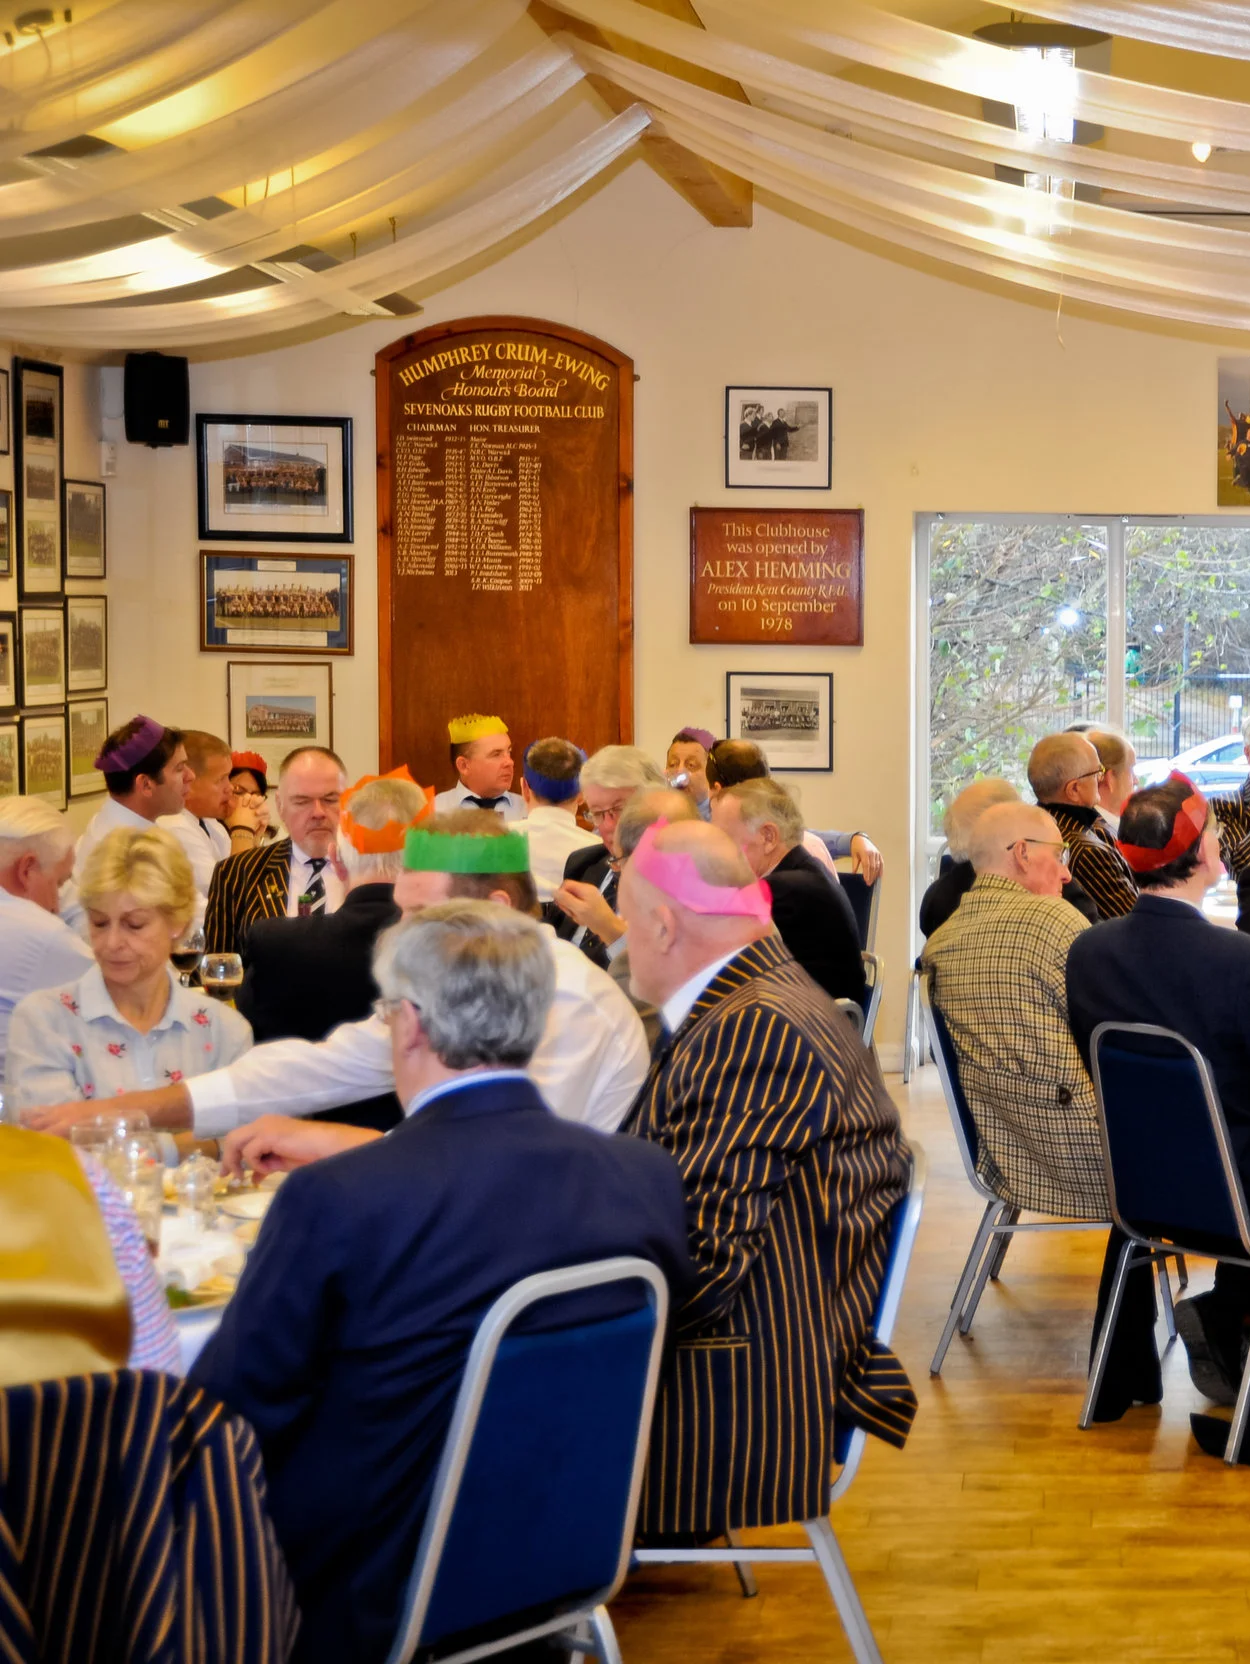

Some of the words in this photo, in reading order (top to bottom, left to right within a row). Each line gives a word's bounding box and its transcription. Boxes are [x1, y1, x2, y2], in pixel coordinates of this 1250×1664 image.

[398, 343, 493, 387] HUMPHREY
[495, 343, 611, 391] CRUM-EWING
[460, 365, 546, 380] Memorial
[441, 380, 511, 400] Honours
[514, 379, 567, 398] Board
[404, 403, 472, 416] SEVENOAKS
[474, 404, 513, 417] RUGBY
[514, 405, 573, 418] FOOTBALL
[574, 406, 604, 418] CLUB
[406, 423, 457, 432] CHAIRMAN
[492, 425, 541, 434] TREASURER
[722, 522, 751, 537] This
[755, 522, 830, 537] Clubhouse
[727, 543, 752, 553] was
[755, 541, 807, 557] opened
[811, 541, 828, 559] by
[700, 560, 749, 578] ALEX
[755, 561, 850, 579] HEMMING
[708, 583, 753, 595] President
[755, 584, 778, 596] Kent
[780, 584, 816, 598] County
[718, 601, 736, 611] on
[742, 599, 757, 612] 10
[761, 599, 836, 615] September
[760, 617, 793, 632] 1978
